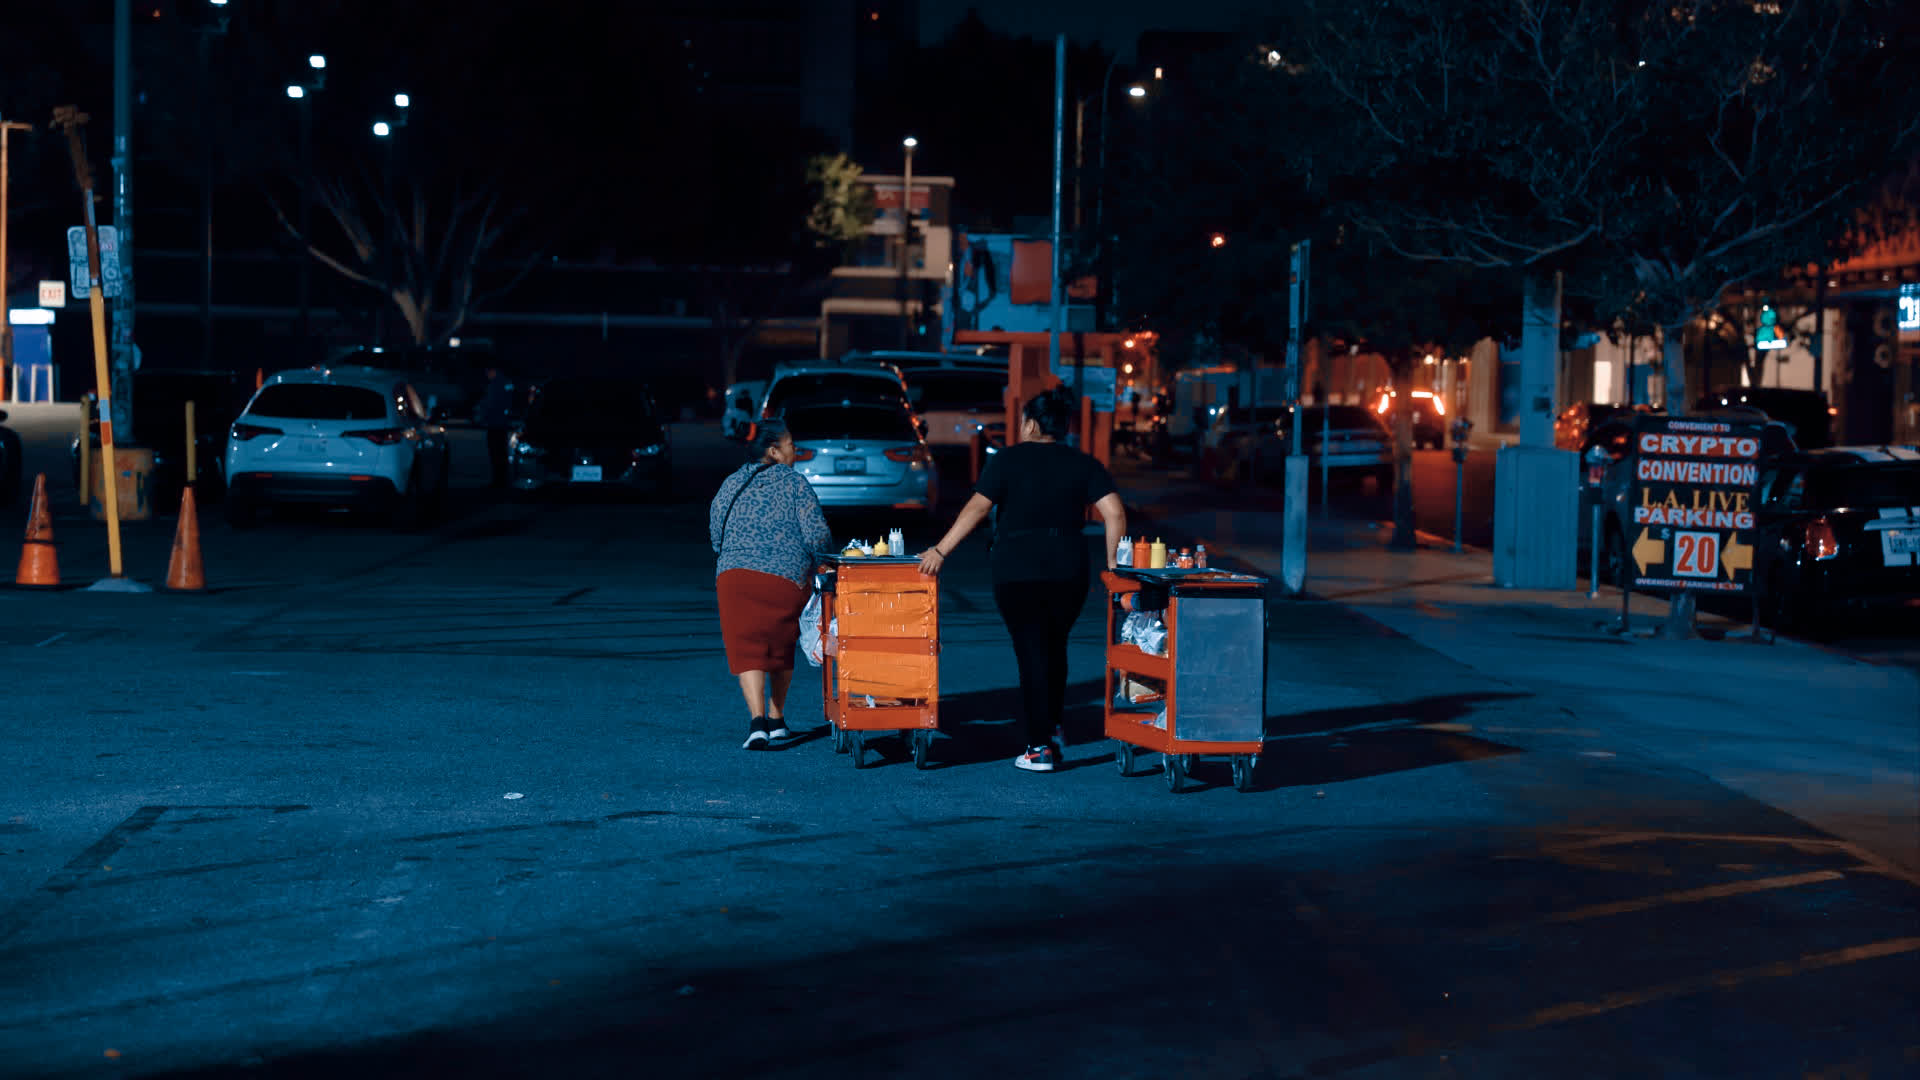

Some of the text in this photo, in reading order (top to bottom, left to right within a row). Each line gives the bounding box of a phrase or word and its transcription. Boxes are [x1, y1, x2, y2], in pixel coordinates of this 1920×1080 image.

[1668, 421, 1718, 432] CONVENIENT
[1641, 434, 1757, 456] CRYPTO
[1638, 460, 1756, 485] CONVENTION
[1642, 487, 1750, 512] L.A. LIVE
[1634, 506, 1753, 528] PARKING
[1677, 535, 1715, 573] 20
